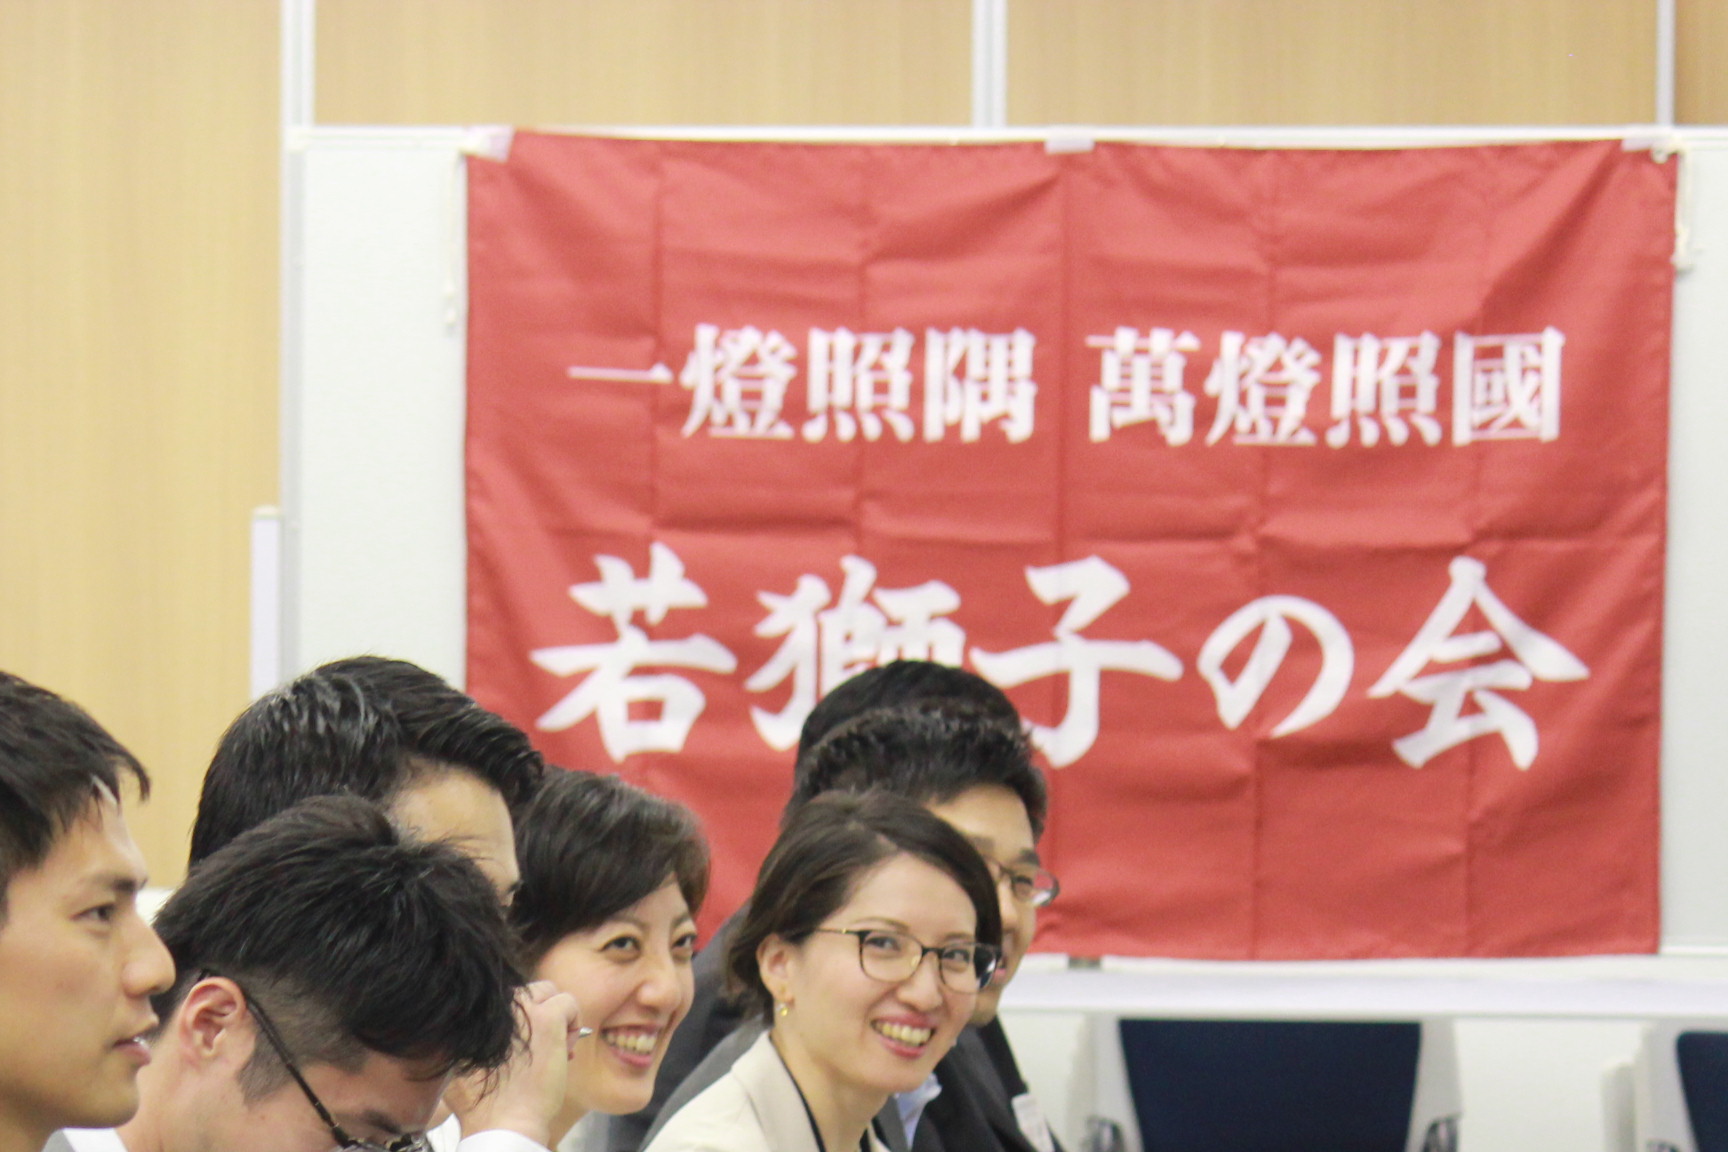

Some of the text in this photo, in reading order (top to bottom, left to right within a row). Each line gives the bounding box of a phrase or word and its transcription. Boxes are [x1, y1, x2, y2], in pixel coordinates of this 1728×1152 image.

[568, 323, 1568, 447] 一燈照隅 萬燈照國
[531, 541, 1590, 770] 若獅子の会
